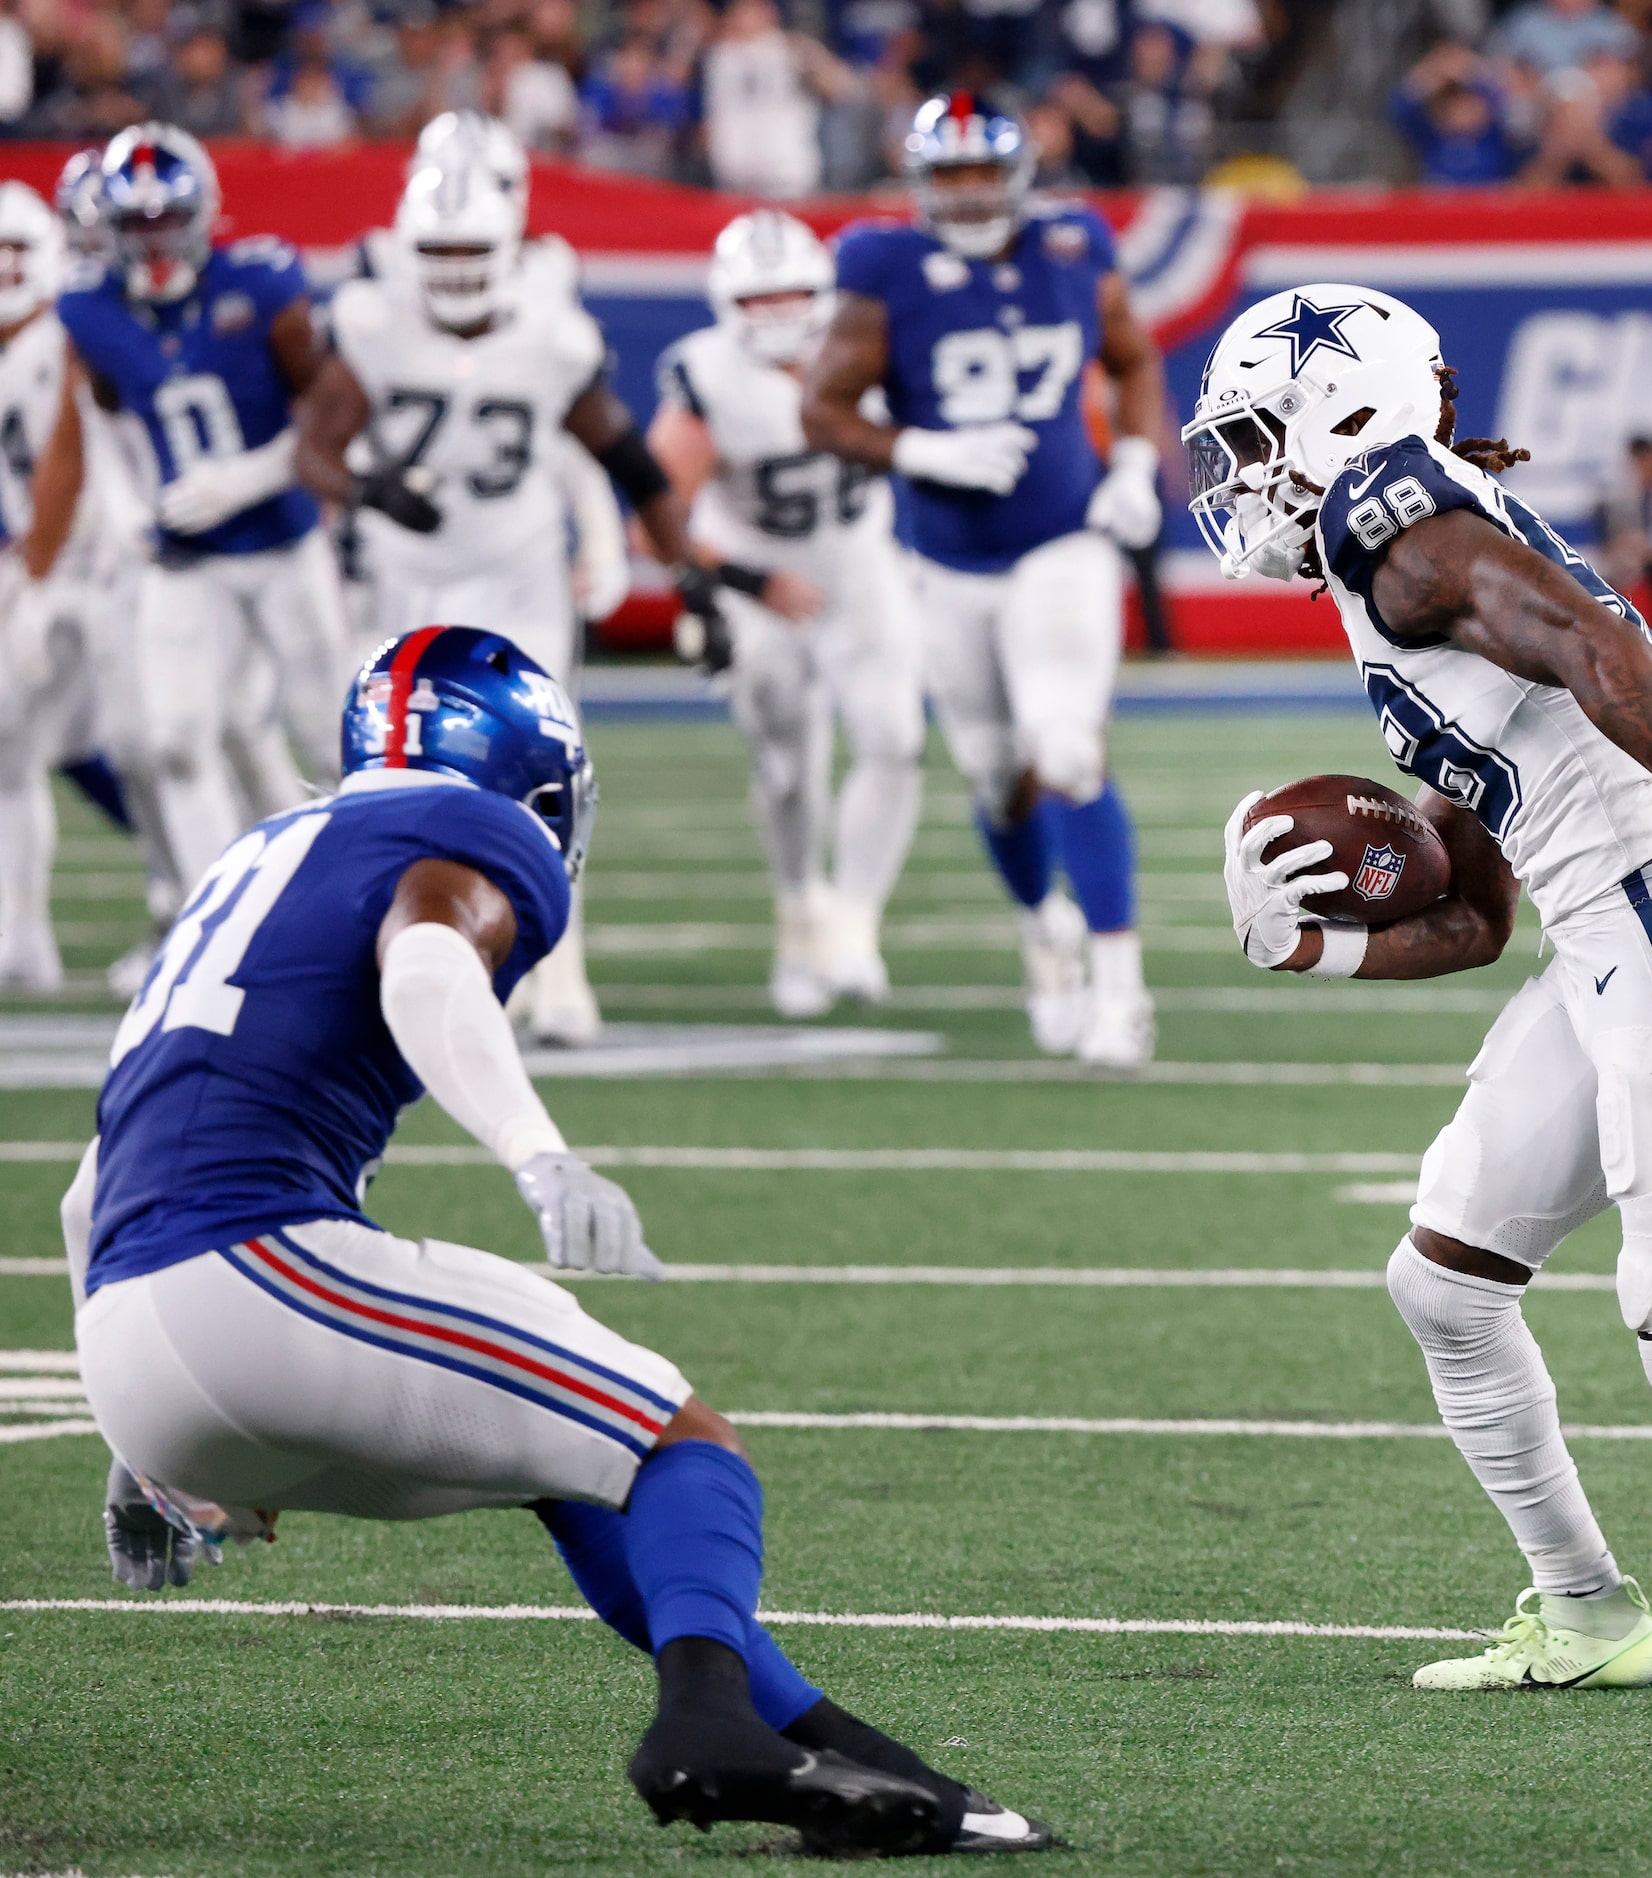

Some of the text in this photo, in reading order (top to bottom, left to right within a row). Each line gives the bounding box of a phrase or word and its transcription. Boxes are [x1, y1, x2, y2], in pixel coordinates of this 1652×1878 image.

[154, 372, 250, 468] 0
[931, 320, 1083, 424] 97
[375, 385, 536, 500] 73
[1346, 475, 1437, 550] 88
[1359, 867, 1392, 894] NFL
[109, 811, 333, 1071] 31
